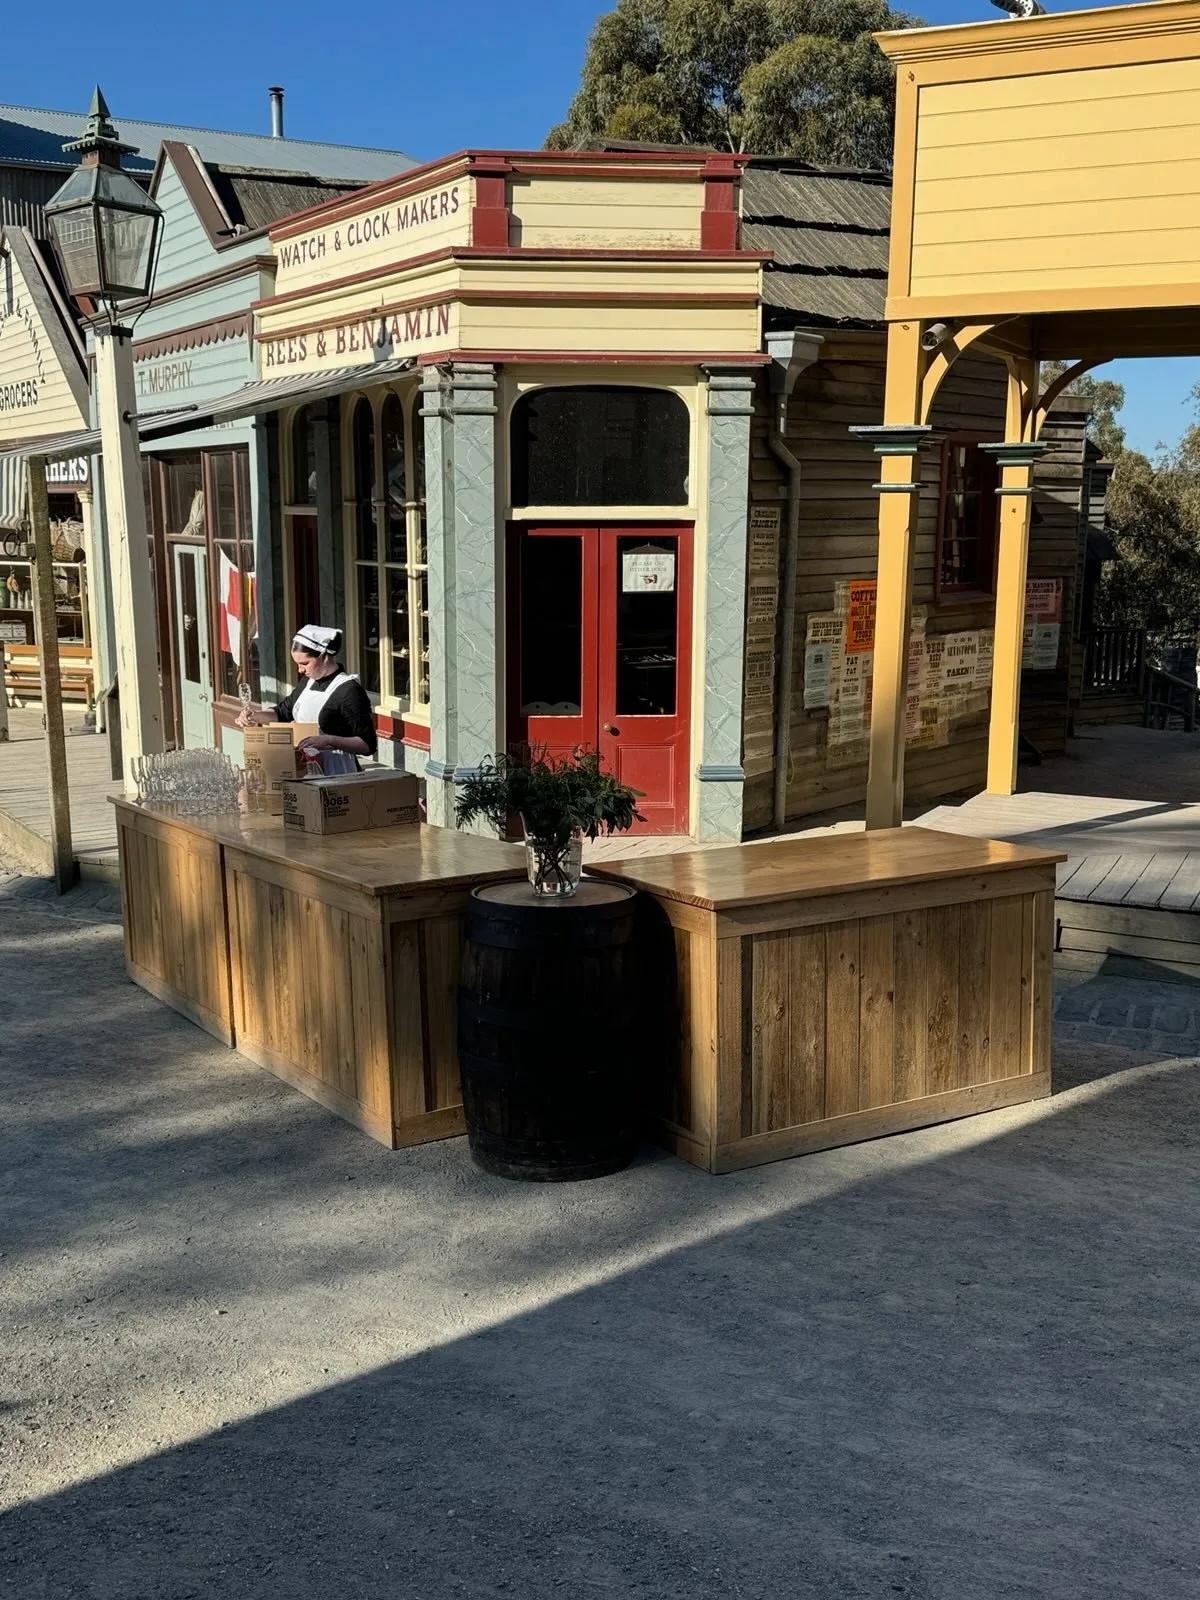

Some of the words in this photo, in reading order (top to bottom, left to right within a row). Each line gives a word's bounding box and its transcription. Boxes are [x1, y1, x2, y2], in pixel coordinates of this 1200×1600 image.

[280, 234, 326, 269] WATCH
[334, 230, 342, 252] &
[348, 211, 390, 247] CLOCK
[397, 186, 459, 232] MAKERS
[266, 336, 307, 367] REES
[316, 329, 327, 358] &
[336, 304, 452, 354] BENJAMIN
[0, 379, 38, 411] GROCERS
[45, 455, 88, 482] HERS
[946, 665, 975, 678] TAKEN!!
